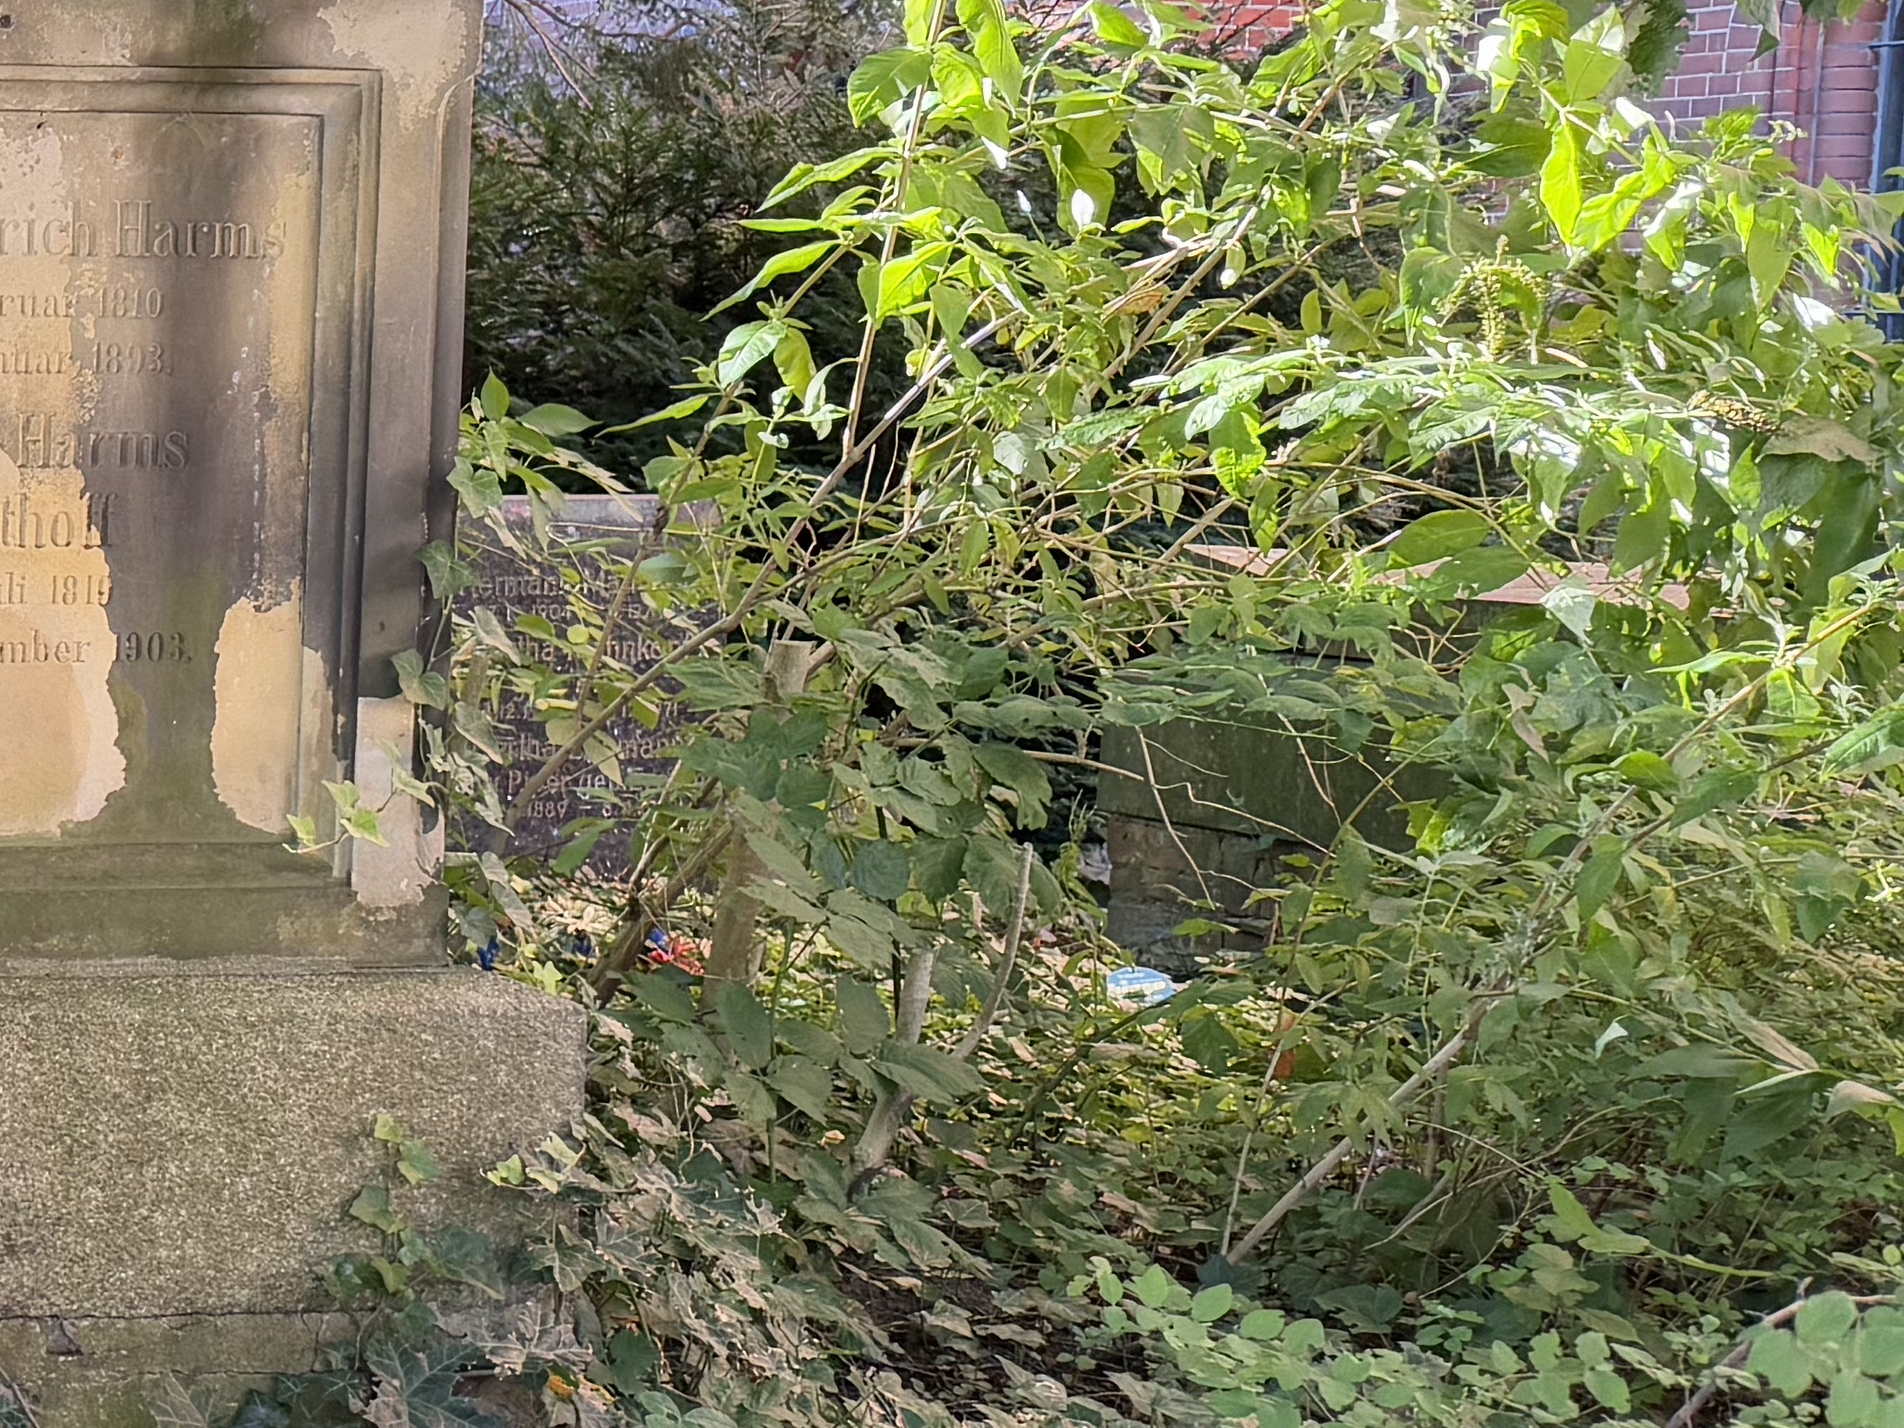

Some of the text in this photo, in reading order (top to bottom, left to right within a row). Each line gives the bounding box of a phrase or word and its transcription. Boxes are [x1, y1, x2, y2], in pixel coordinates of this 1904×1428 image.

[100, 199, 286, 262] Harms
[96, 286, 165, 320] 1810
[17, 411, 191, 470] Harms
